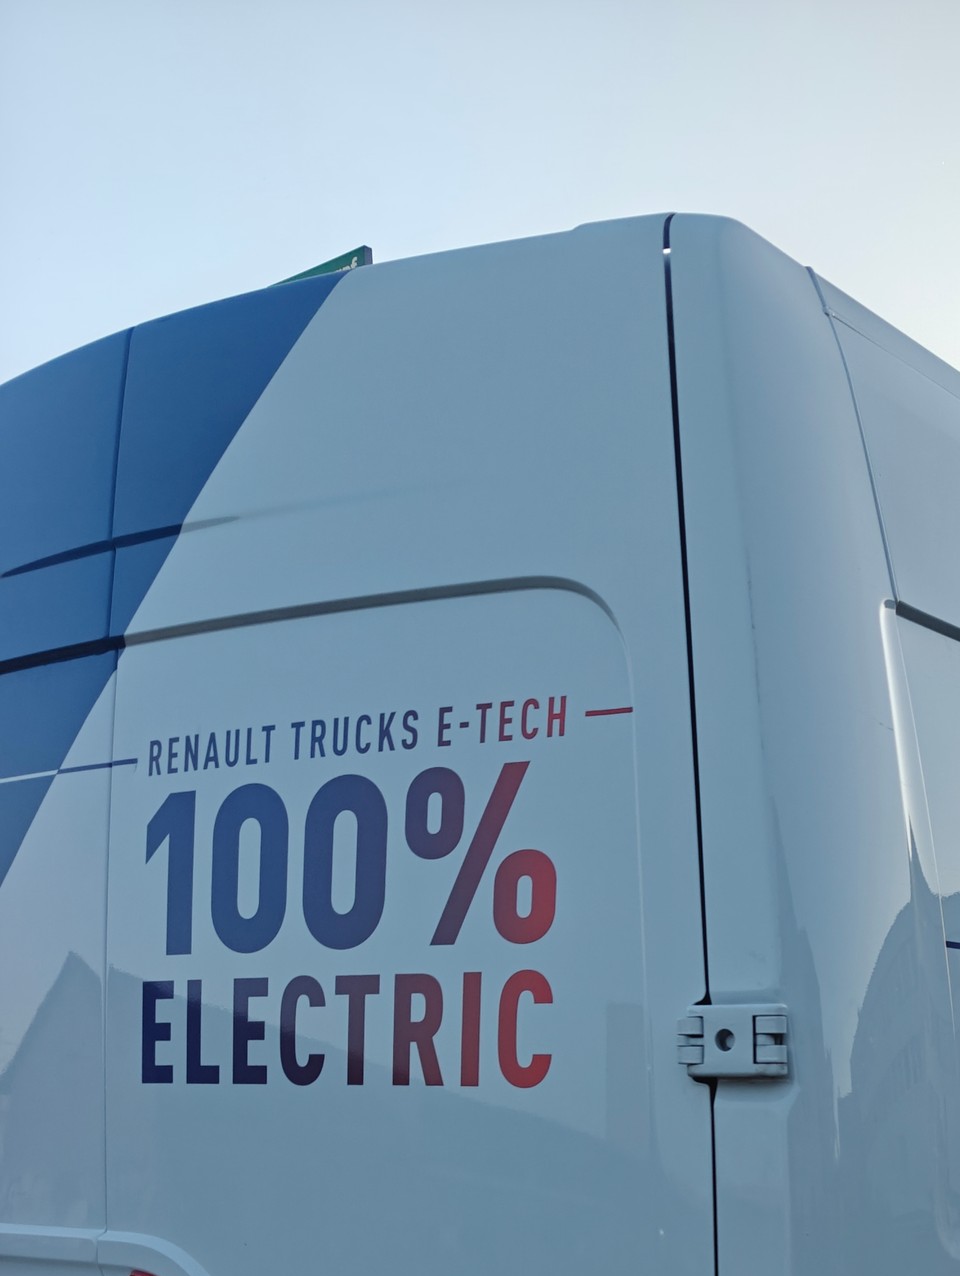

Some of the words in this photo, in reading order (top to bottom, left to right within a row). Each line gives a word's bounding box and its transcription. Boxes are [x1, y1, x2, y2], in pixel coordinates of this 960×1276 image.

[148, 725, 275, 776] RENAULT
[291, 709, 419, 761] TRUCKS
[438, 695, 567, 747] E-TECH
[145, 761, 557, 956] 100%
[142, 969, 554, 1089] ELECTRIC
